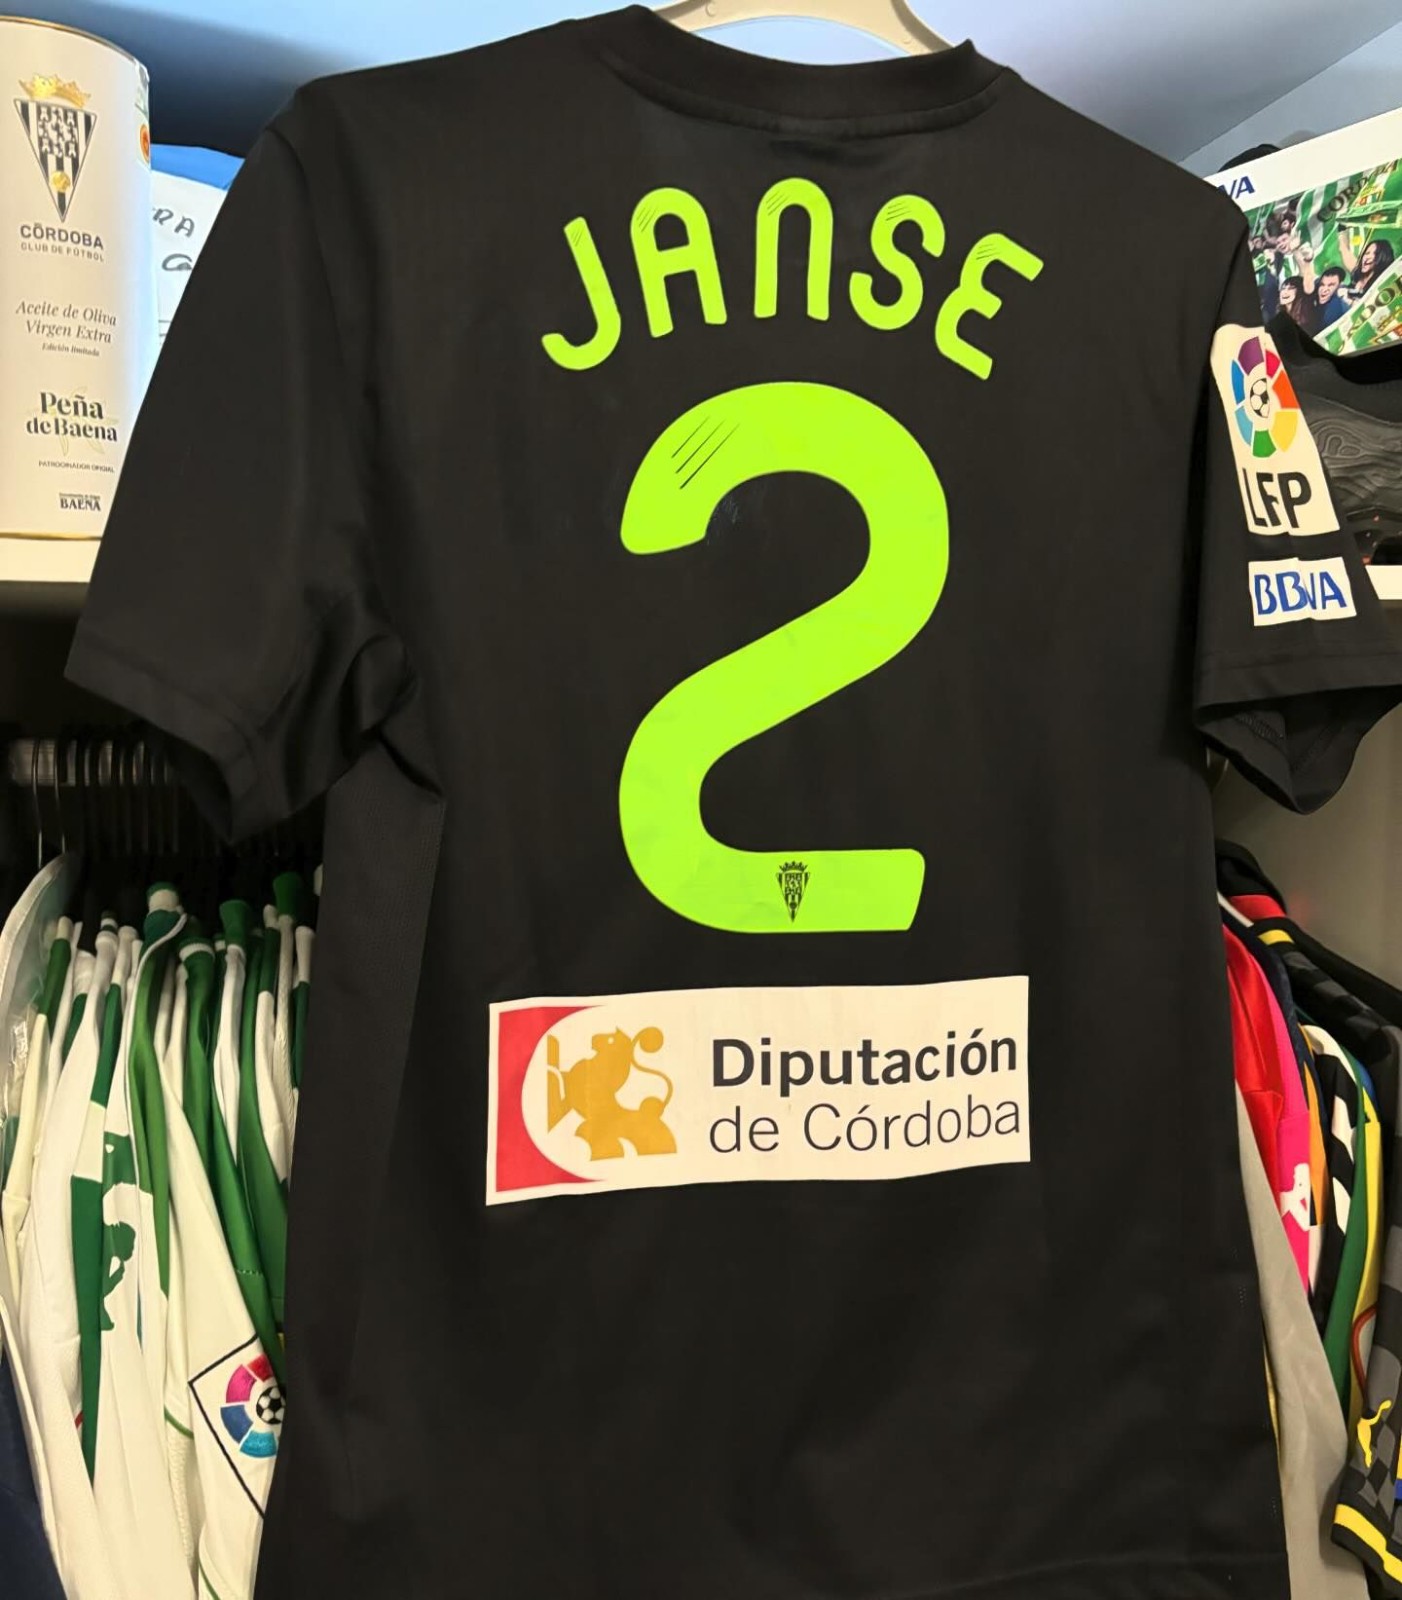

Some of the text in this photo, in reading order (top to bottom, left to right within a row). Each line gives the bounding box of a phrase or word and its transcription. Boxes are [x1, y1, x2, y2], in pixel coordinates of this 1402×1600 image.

[21, 241, 48, 252] CLUB
[51, 244, 63, 254] DE
[541, 177, 1045, 380] JANSE
[15, 300, 116, 327] Aceite de Oliva
[26, 319, 111, 343] Virgen Extra
[40, 391, 104, 420] Peña
[26, 417, 118, 442] de Baena
[60, 498, 102, 512] BAENA
[1241, 466, 1313, 529] LFP
[1254, 570, 1348, 616] BBVA
[620, 381, 950, 933] 2
[712, 1028, 1018, 1098] Diputación
[709, 1094, 1021, 1154] de Córdoba
